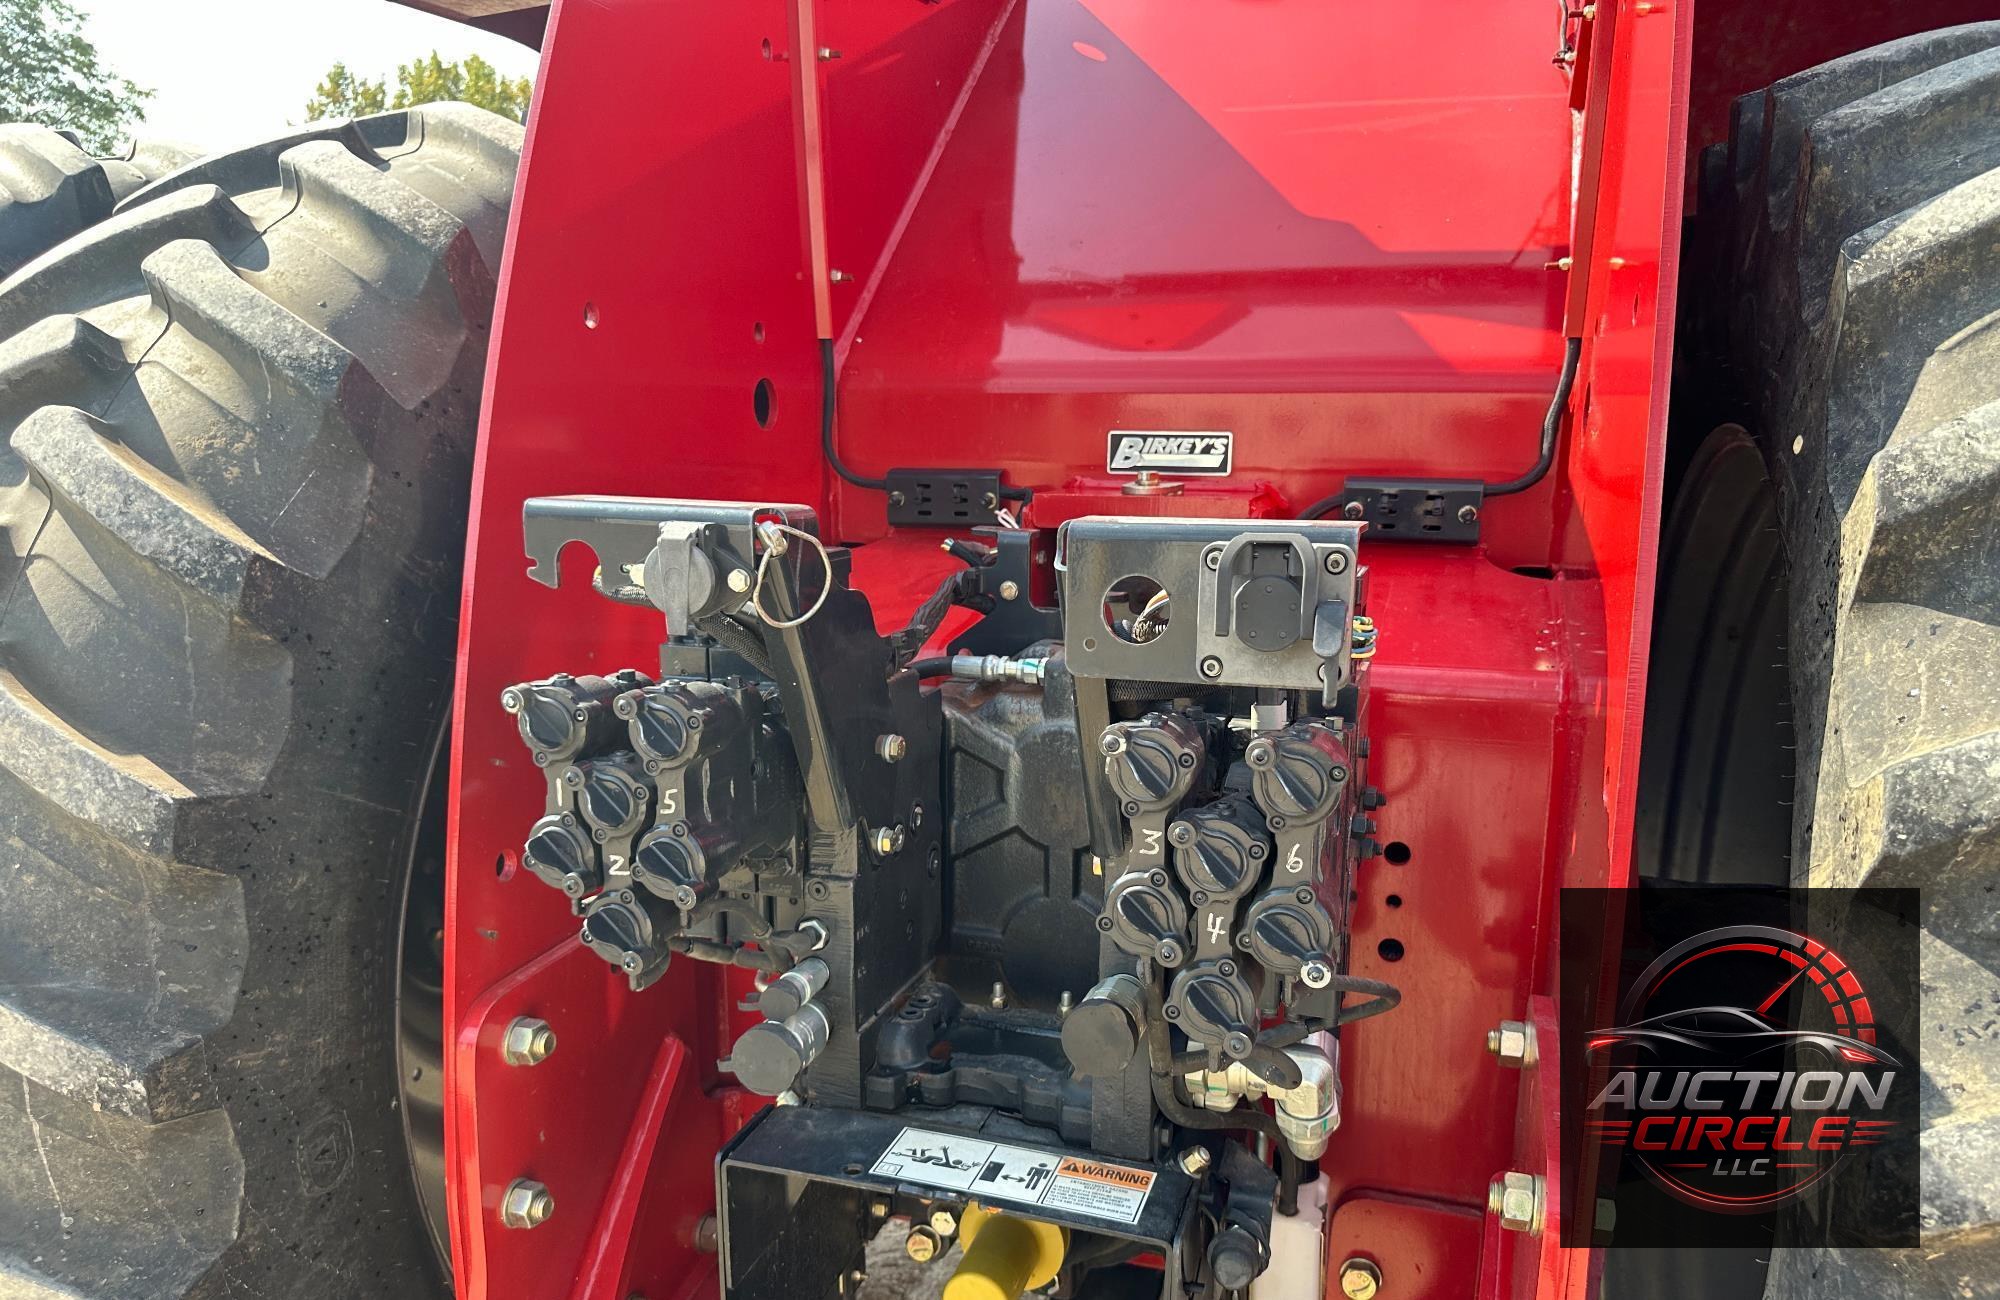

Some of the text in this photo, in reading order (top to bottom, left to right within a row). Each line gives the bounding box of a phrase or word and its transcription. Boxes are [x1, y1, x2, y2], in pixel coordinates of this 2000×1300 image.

[1111, 436, 1228, 469] BIRKEY'S
[556, 777, 563, 807] 1
[660, 788, 678, 814] 5
[1139, 829, 1162, 856] 3
[609, 854, 630, 876] 2
[1286, 843, 1303, 873] 6
[1206, 912, 1226, 944] 4
[1081, 1164, 1150, 1186] WARNING
